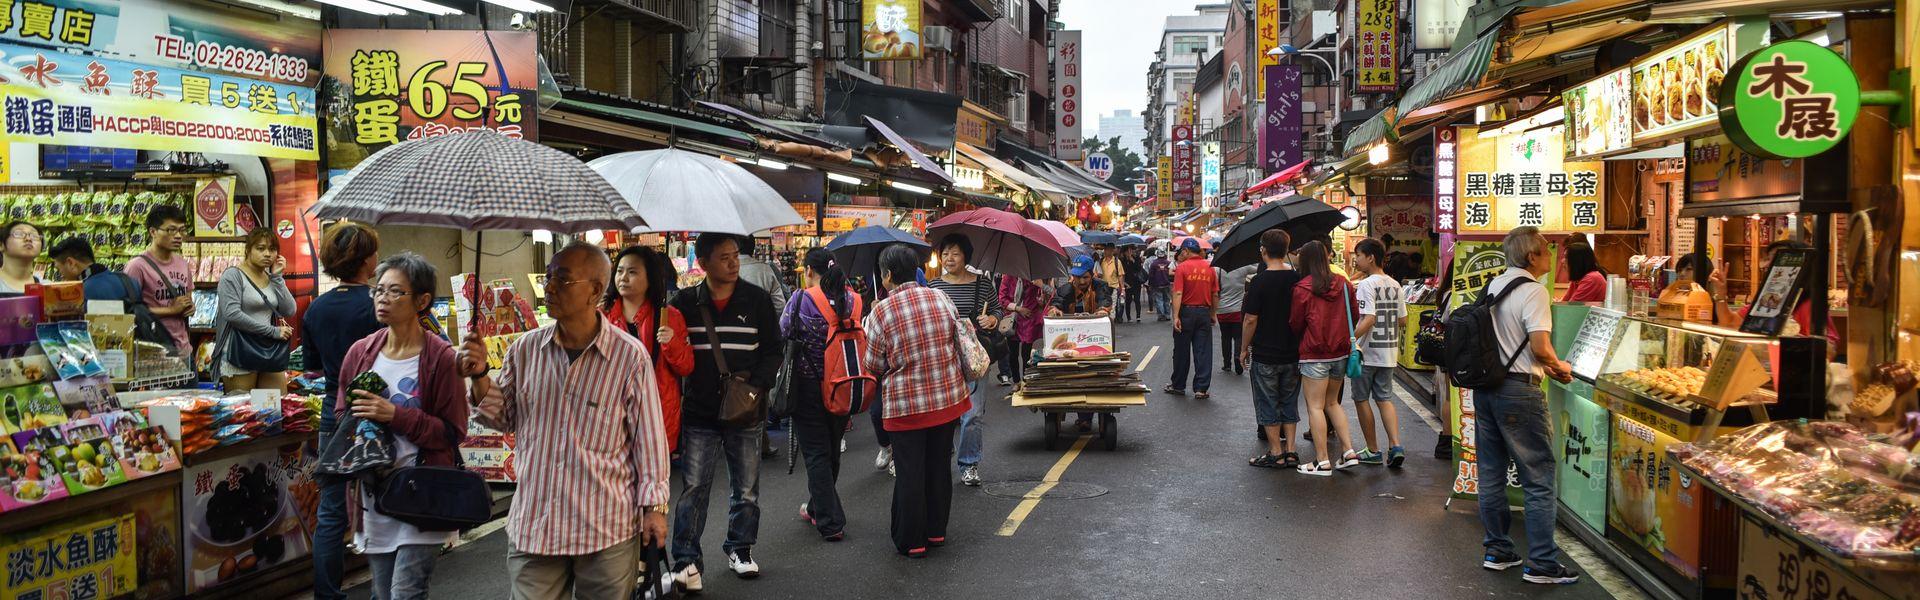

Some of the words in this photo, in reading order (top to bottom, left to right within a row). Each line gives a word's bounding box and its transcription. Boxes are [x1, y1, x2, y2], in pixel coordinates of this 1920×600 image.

[155, 36, 192, 60] TEL:
[197, 44, 307, 78] 02-2622-1333
[0, 54, 165, 99] 水魚酥
[352, 50, 399, 144] 鐵蛋
[1750, 56, 1838, 138] 木屐
[1089, 157, 1109, 170] WC
[1466, 173, 1597, 196] 黑糖薑母茶
[1203, 197, 1219, 208] 100
[1466, 202, 1597, 225] 海燕窩
[1454, 269, 1507, 291] 全面大
[1372, 310, 1399, 341] 99
[7, 524, 118, 588] 淡水魚酥
